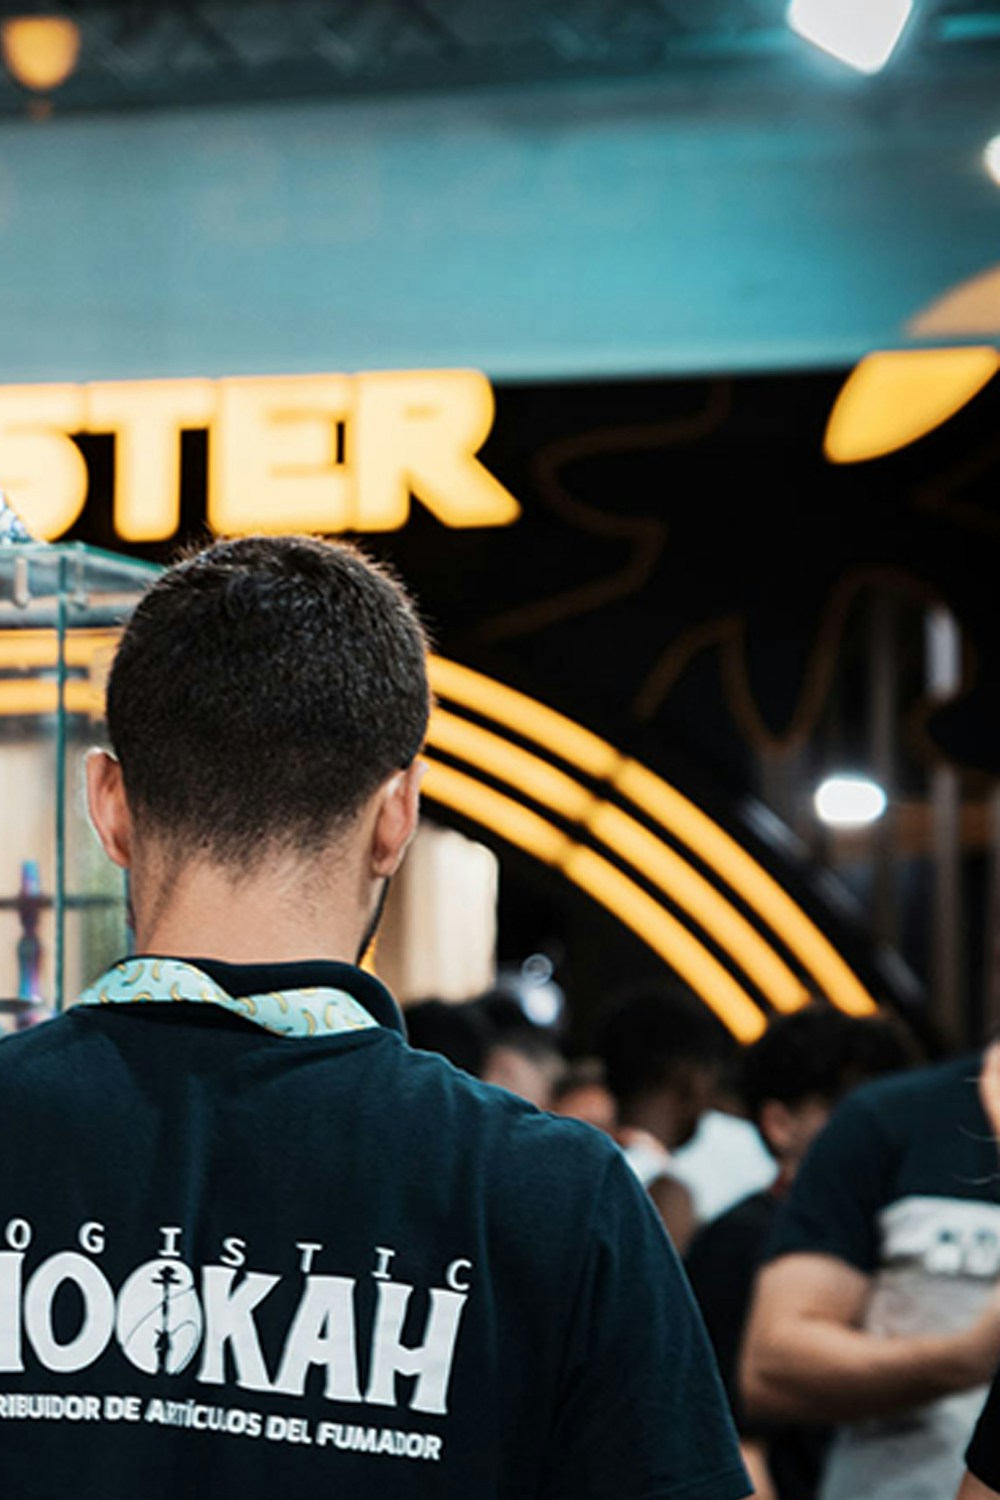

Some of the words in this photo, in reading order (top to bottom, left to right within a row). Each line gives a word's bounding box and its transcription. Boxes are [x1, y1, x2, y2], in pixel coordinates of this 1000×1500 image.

[103, 1395, 143, 1422] DE
[265, 1414, 312, 1446] DEL
[316, 1420, 443, 1462] FUMADOR
